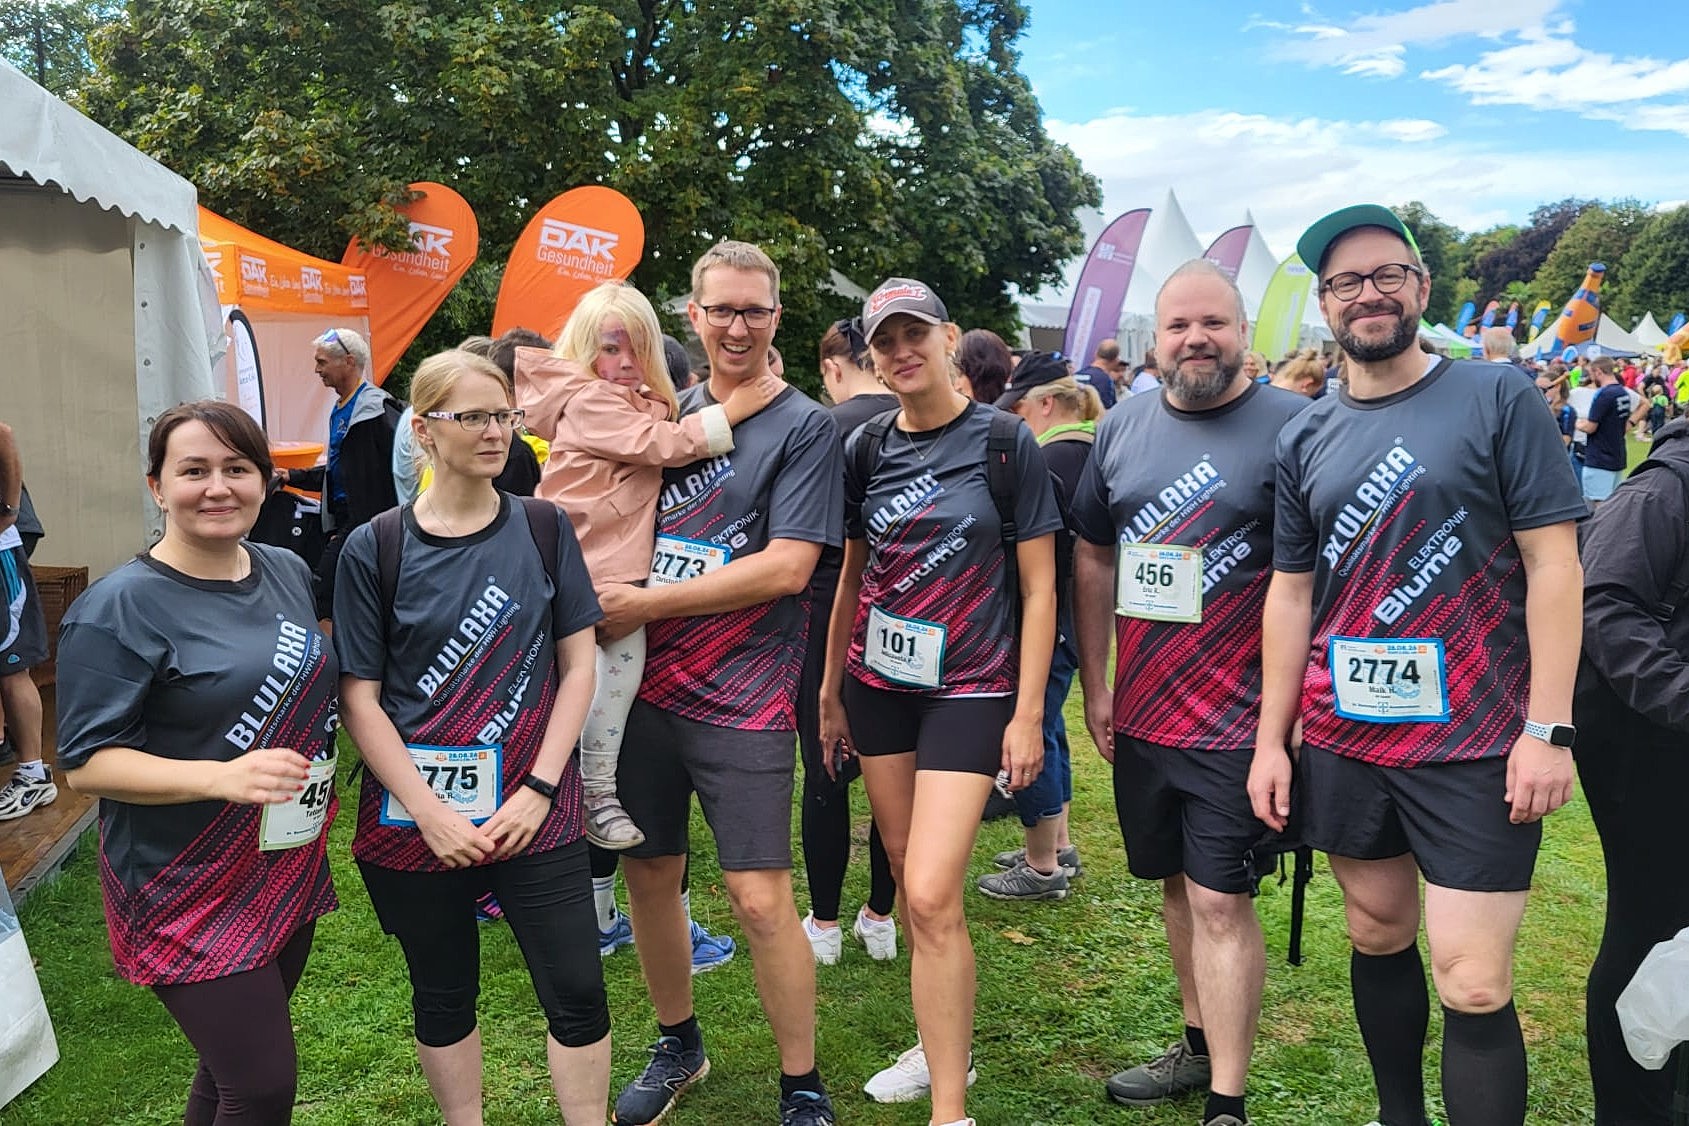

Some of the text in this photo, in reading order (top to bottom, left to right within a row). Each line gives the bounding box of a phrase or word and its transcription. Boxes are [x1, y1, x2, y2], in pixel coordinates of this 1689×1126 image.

[539, 218, 619, 261] DAK
[241, 256, 268, 283] DAK
[536, 245, 615, 276] Gesundheit
[301, 267, 323, 290] DAK
[1398, 464, 1427, 495] Lighting
[710, 508, 760, 545] EKTRONIK
[1407, 505, 1470, 570] ELEKTRONIK
[652, 551, 706, 579] 2773
[1135, 562, 1174, 587] 456
[1373, 535, 1463, 626] Blume
[496, 602, 521, 630] Lighting
[881, 628, 916, 657] 101
[291, 680, 303, 696] der
[299, 659, 315, 682] HWH
[1348, 657, 1421, 685] 2774
[415, 763, 479, 791] 775
